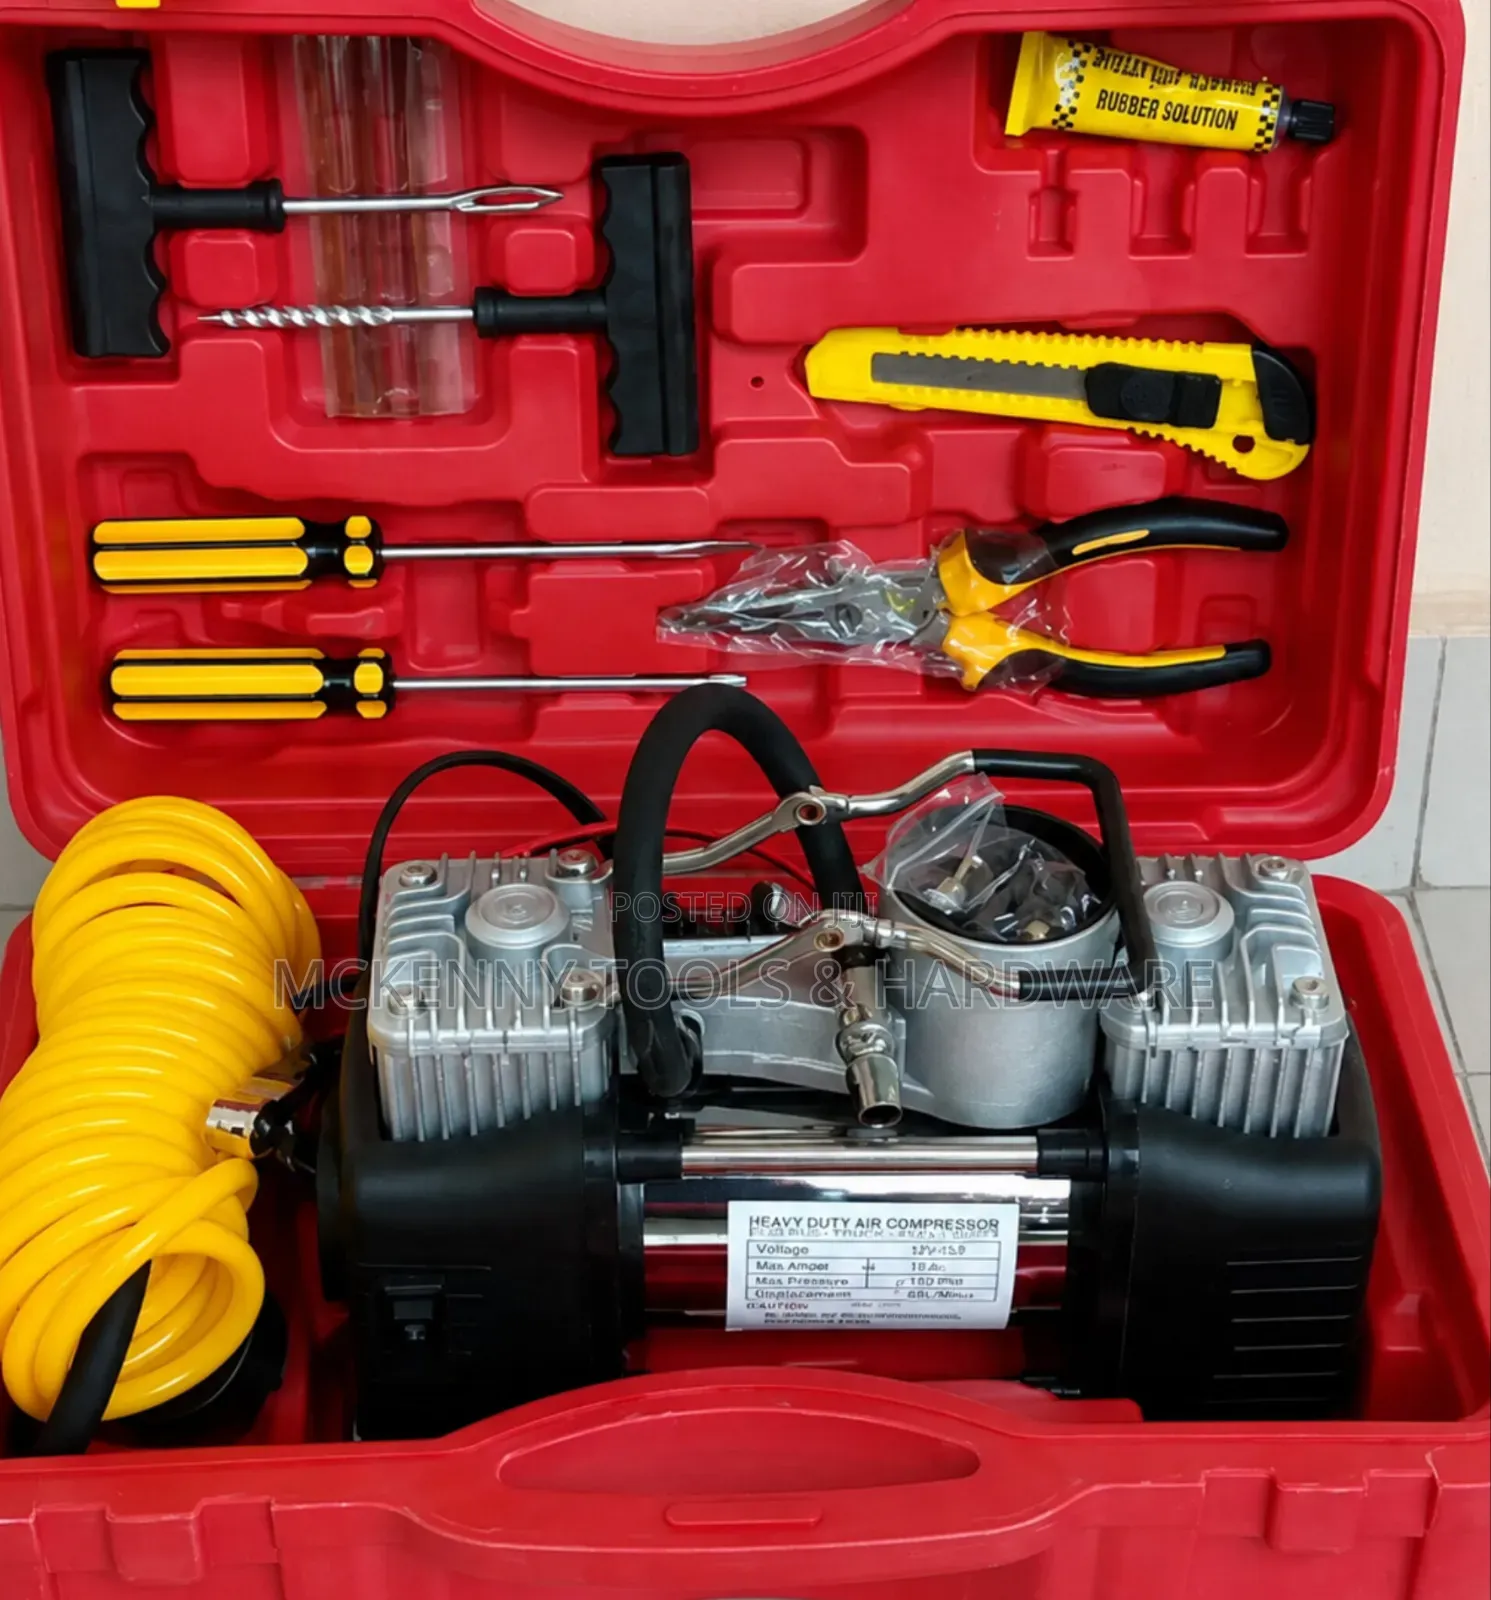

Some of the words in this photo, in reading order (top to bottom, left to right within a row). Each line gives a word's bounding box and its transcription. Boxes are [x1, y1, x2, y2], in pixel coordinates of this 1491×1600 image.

[1096, 89, 1160, 120] RUBBER
[1161, 102, 1239, 131] SOLUTION
[749, 1215, 803, 1228] HEAVY
[807, 1216, 850, 1230] DUTY
[855, 1217, 881, 1230] AIR
[886, 1217, 1000, 1231] COMPRESSOR
